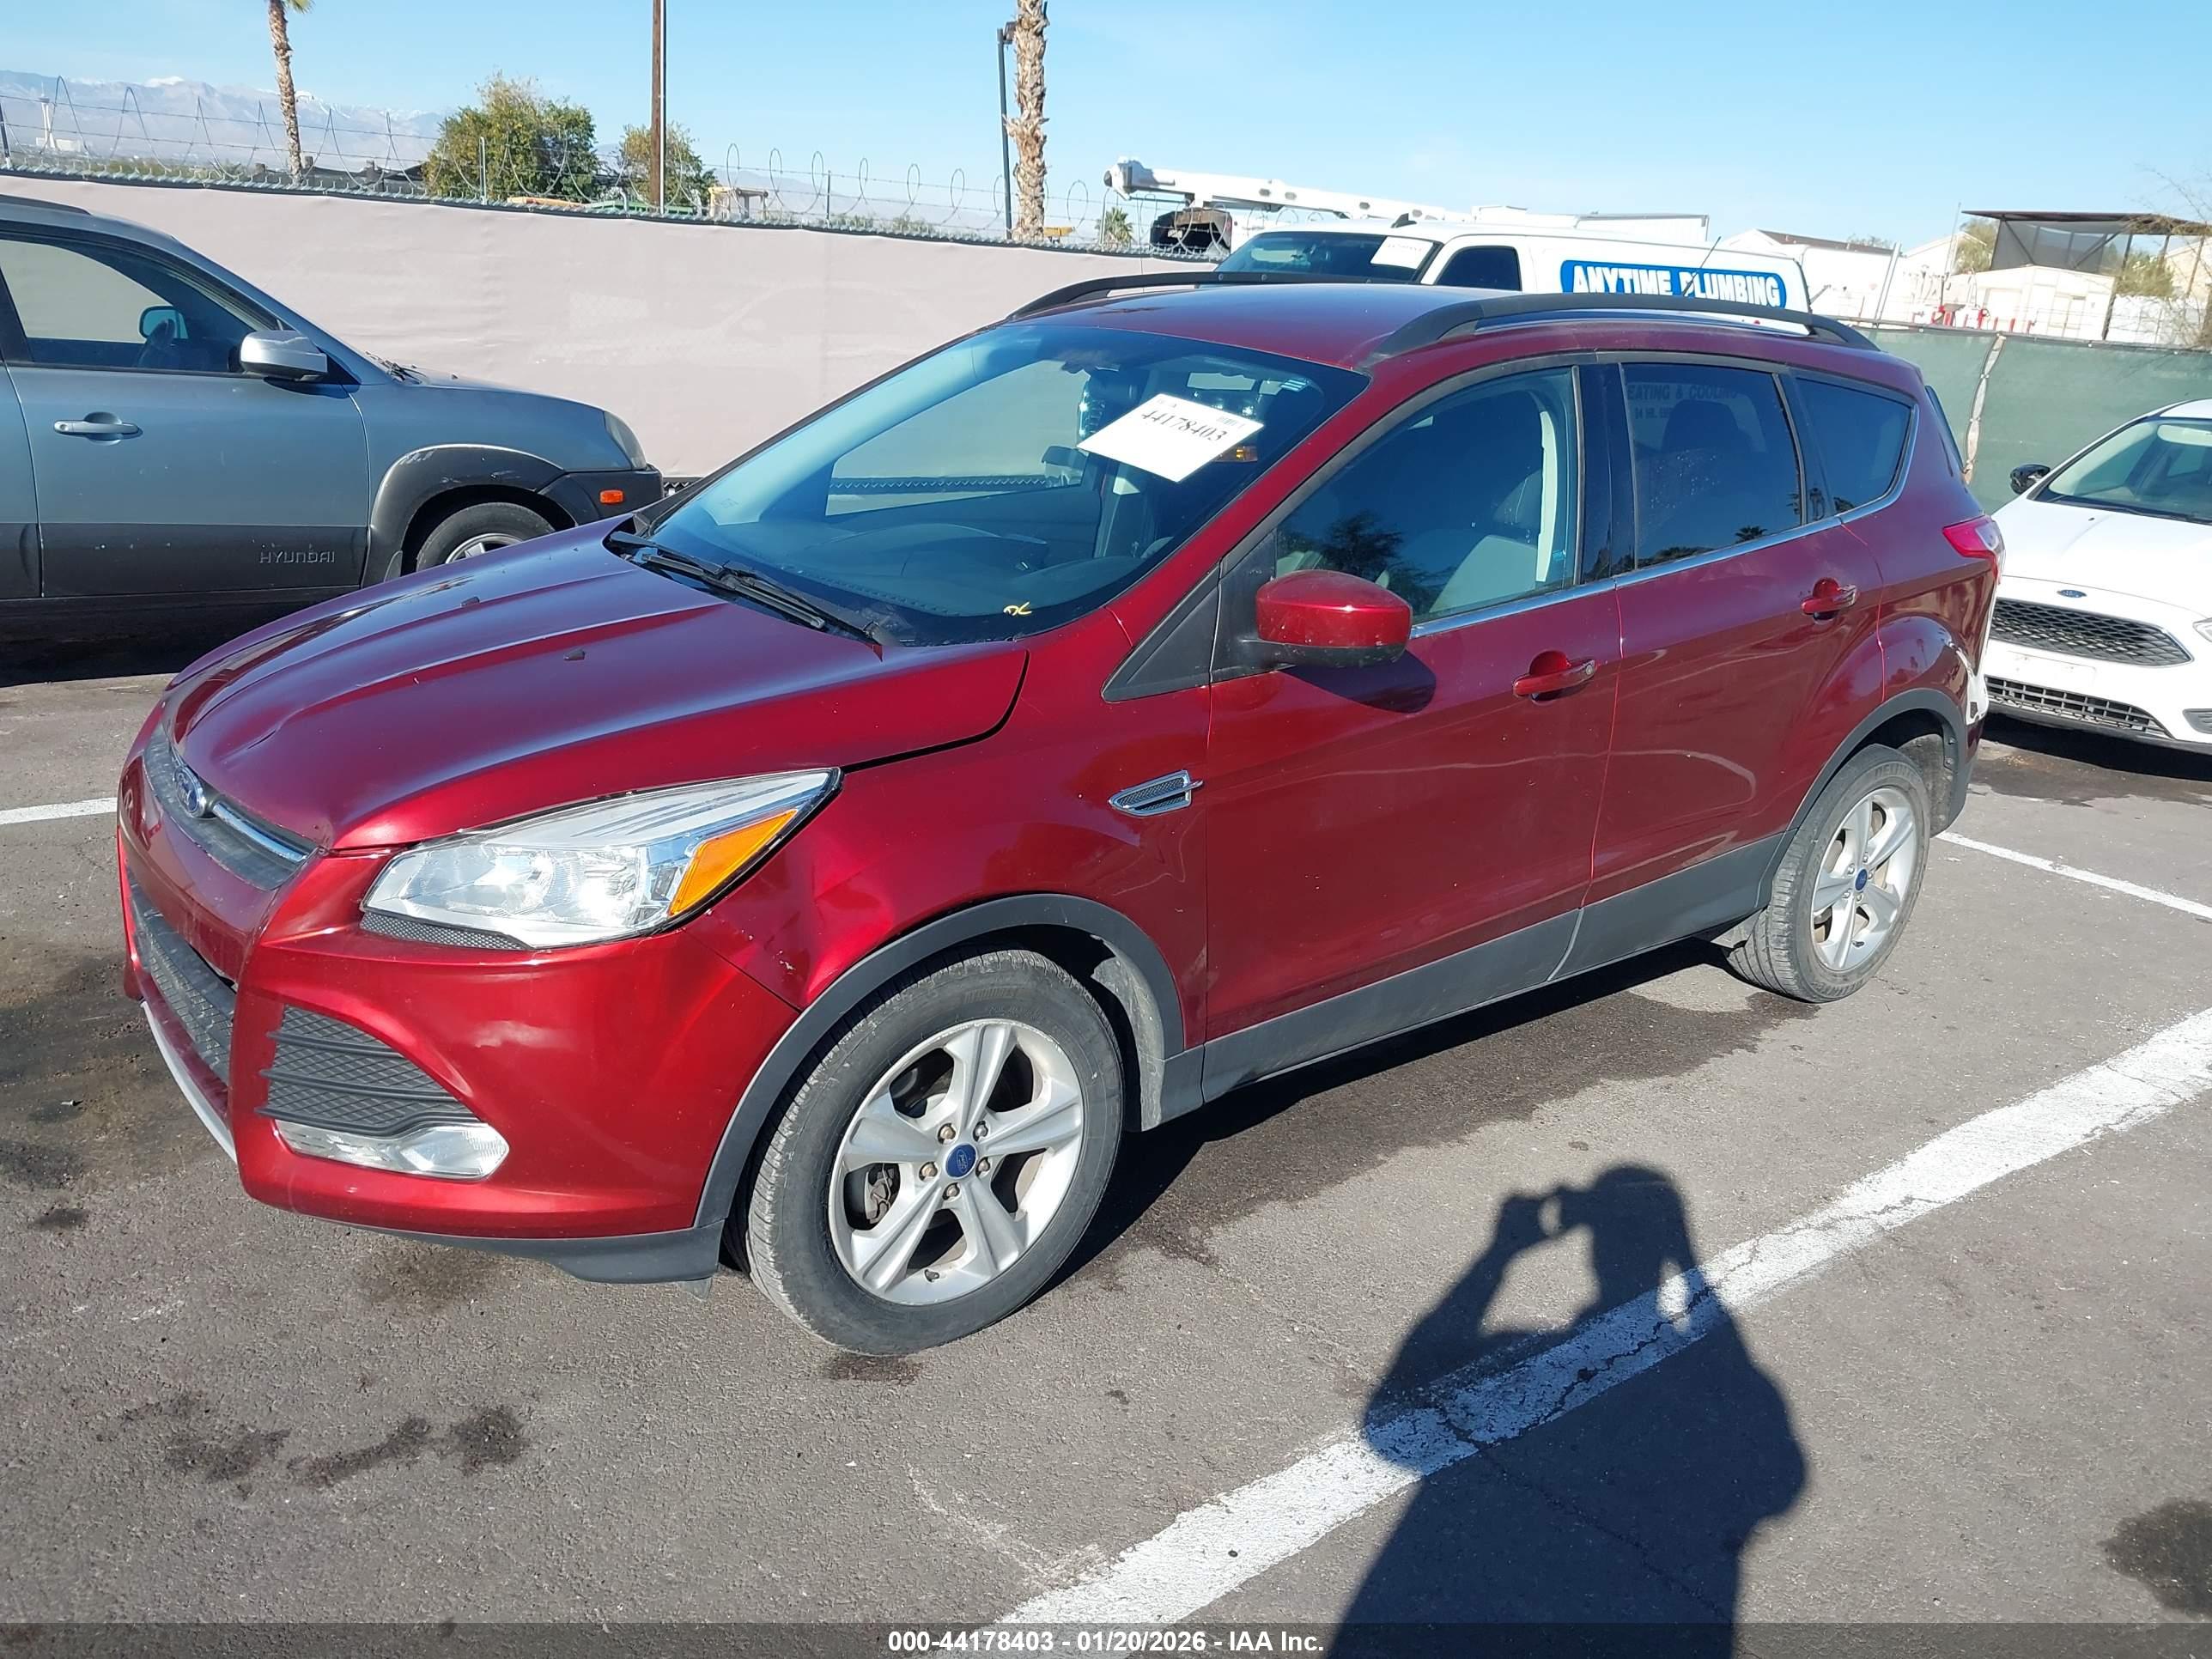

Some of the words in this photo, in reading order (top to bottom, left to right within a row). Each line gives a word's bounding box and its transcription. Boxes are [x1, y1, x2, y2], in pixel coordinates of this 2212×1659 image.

[1572, 264, 1674, 296] ANYTIME
[1679, 270, 1782, 308] PLUMBING
[1141, 410, 1229, 442] 44178403
[259, 550, 335, 563] HYUNDAI
